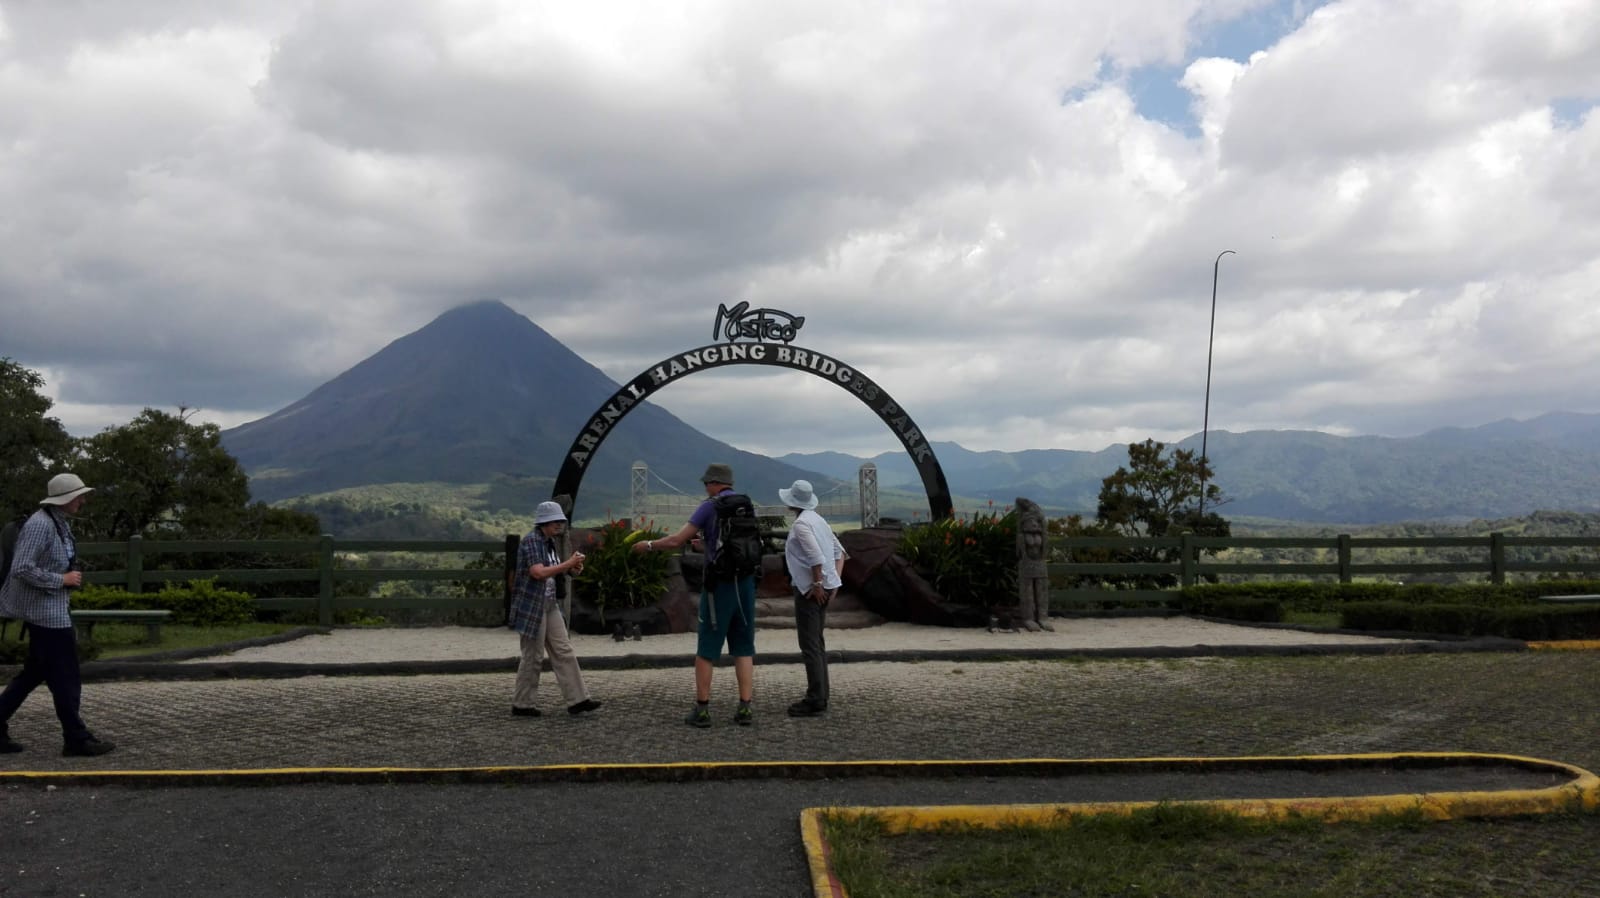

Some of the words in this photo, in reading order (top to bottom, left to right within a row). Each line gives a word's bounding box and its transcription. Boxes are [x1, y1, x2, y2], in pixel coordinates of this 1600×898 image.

[572, 384, 646, 468] ARENAL
[650, 344, 766, 385] HANGING
[776, 346, 879, 401] BRIDGES
[880, 401, 933, 464] PARK
